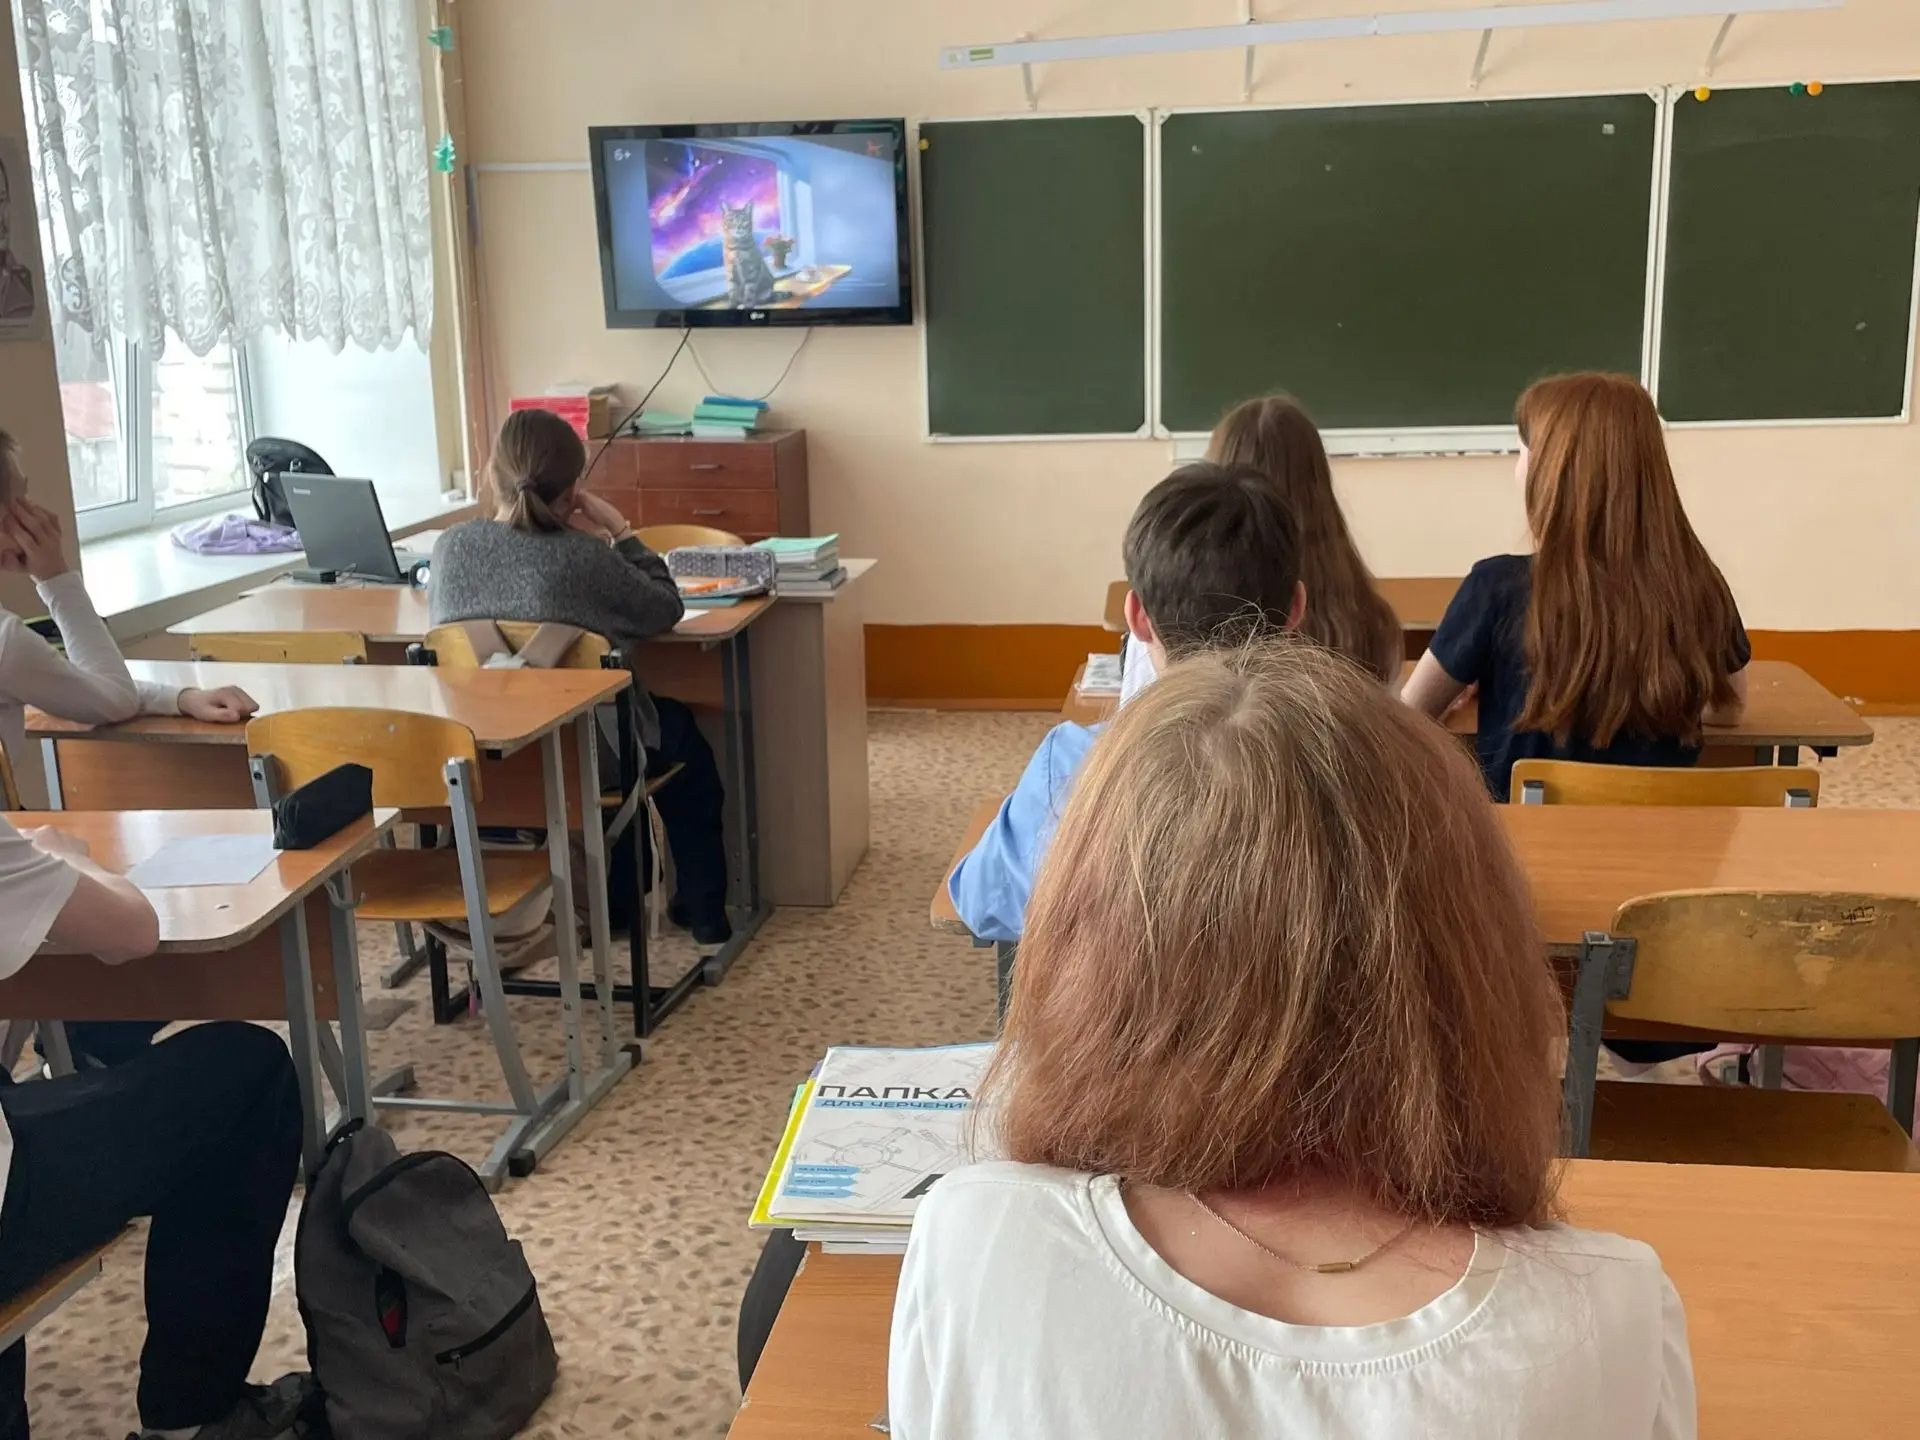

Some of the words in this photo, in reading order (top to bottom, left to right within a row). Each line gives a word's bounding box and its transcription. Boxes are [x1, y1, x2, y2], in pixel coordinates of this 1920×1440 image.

[614, 148, 631, 161] 6+
[817, 1085, 973, 1100] ПАПКА
[821, 1100, 864, 1108] ДЛЯ
